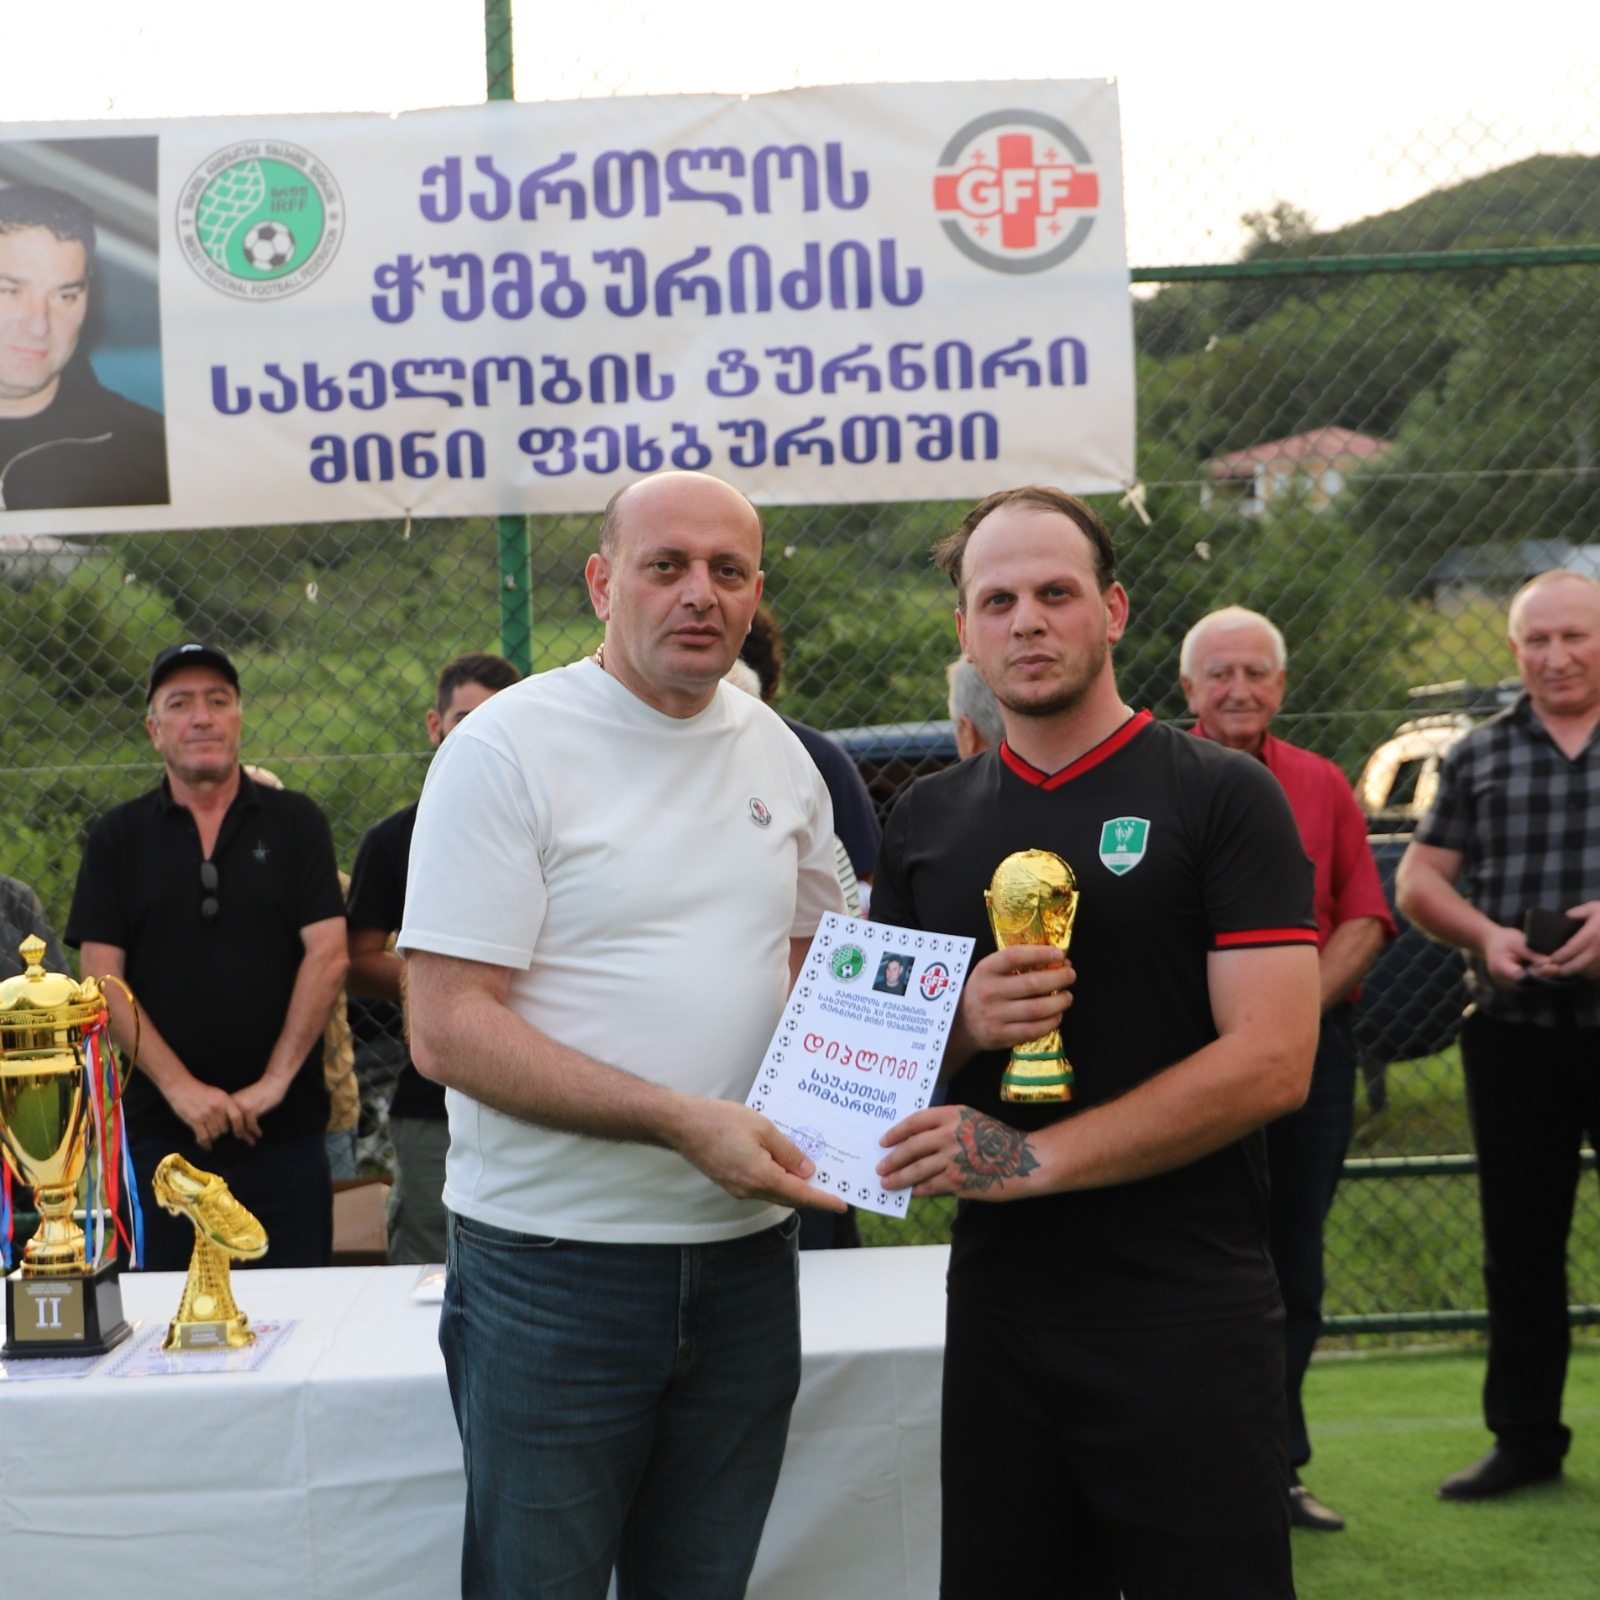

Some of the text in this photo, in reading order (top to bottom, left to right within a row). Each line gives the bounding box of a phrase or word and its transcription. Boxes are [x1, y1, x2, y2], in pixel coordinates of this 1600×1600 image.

[420, 142, 869, 222] ქართლოს
[956, 165, 1074, 218] GFF
[372, 239, 923, 324] ჭუმბურიძის
[211, 336, 1087, 416] სახელობის ტურნირი
[310, 411, 998, 484] მინი ფეხბურთში
[803, 1032, 918, 1081] დიპლომი
[798, 1078, 897, 1121] ბომბარდირი
[811, 1068, 897, 1105] საუკეთესო
[35, 1297, 62, 1329] II
